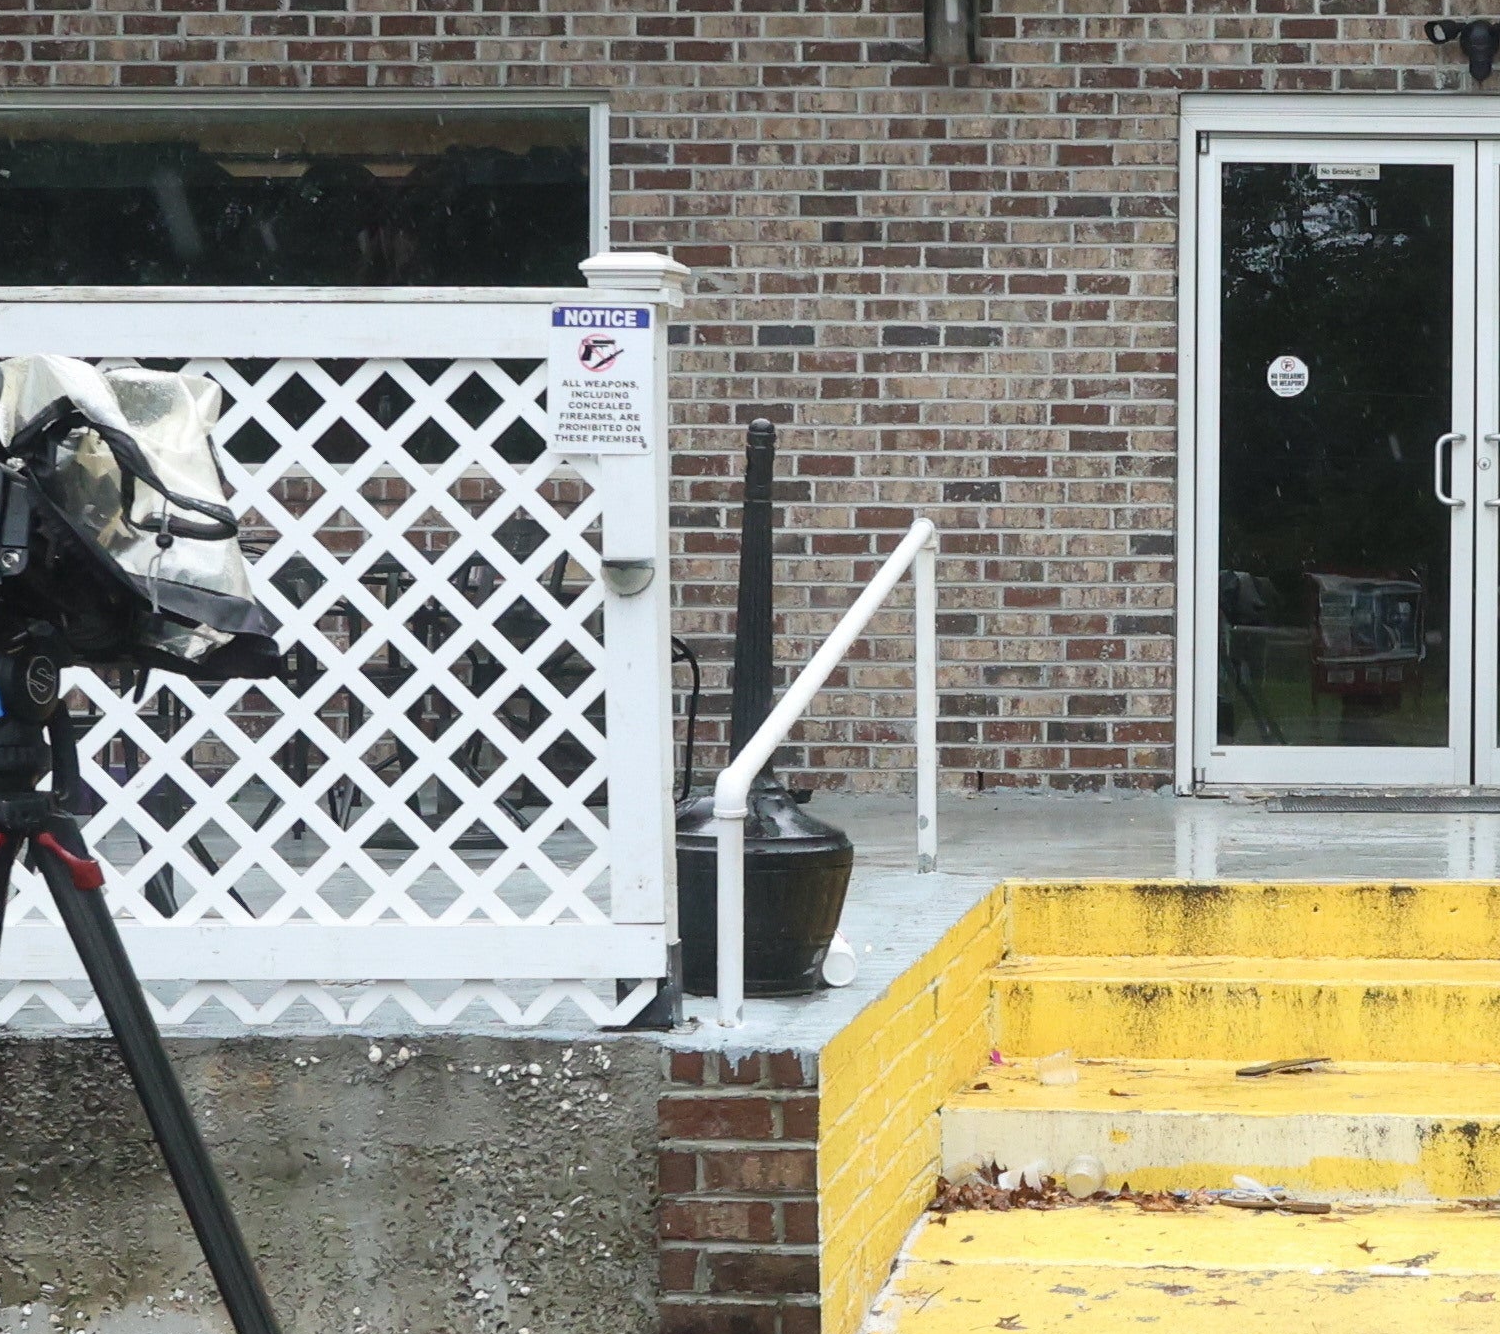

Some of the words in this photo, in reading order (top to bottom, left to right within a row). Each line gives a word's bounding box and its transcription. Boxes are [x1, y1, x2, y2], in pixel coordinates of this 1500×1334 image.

[1320, 167, 1330, 175] No
[564, 309, 637, 327] NOTICE
[584, 380, 639, 389] WEAPONS,
[571, 391, 629, 399] INCLUDING
[568, 401, 632, 410] CONCEALED
[560, 412, 616, 421] FIREARMS,
[620, 413, 640, 421] ARE
[558, 423, 622, 432] PROHIBITED
[625, 424, 641, 432] ON
[554, 434, 588, 442] THESE
[592, 435, 644, 443] PREMISES
